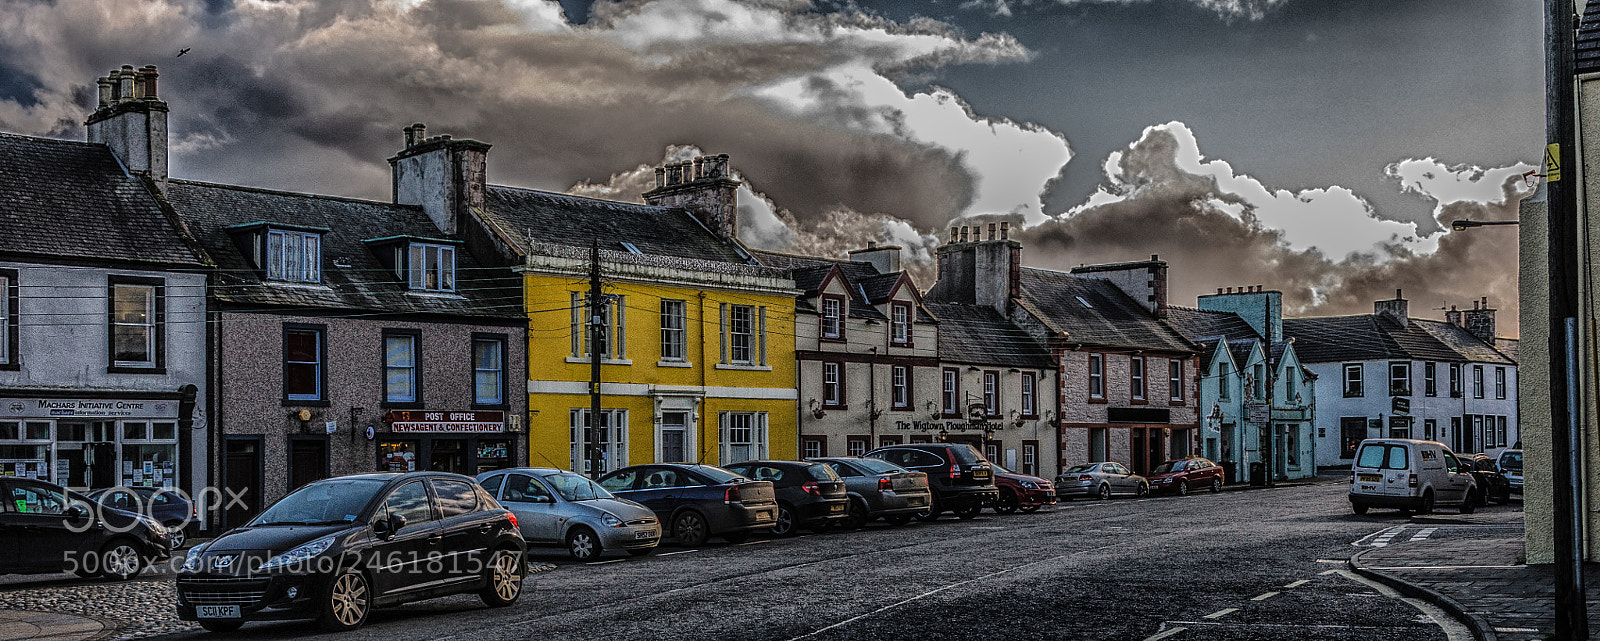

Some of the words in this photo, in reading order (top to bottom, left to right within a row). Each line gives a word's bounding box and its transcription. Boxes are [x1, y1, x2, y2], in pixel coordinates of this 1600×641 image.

[425, 413, 444, 421] POST
[450, 413, 475, 421] OFFICE
[393, 423, 437, 432] NEWSAGENT
[446, 423, 502, 432] CONFECTIONERY
[896, 421, 911, 430] The
[913, 421, 944, 432] Wigtown
[218, 606, 234, 616] KPF
